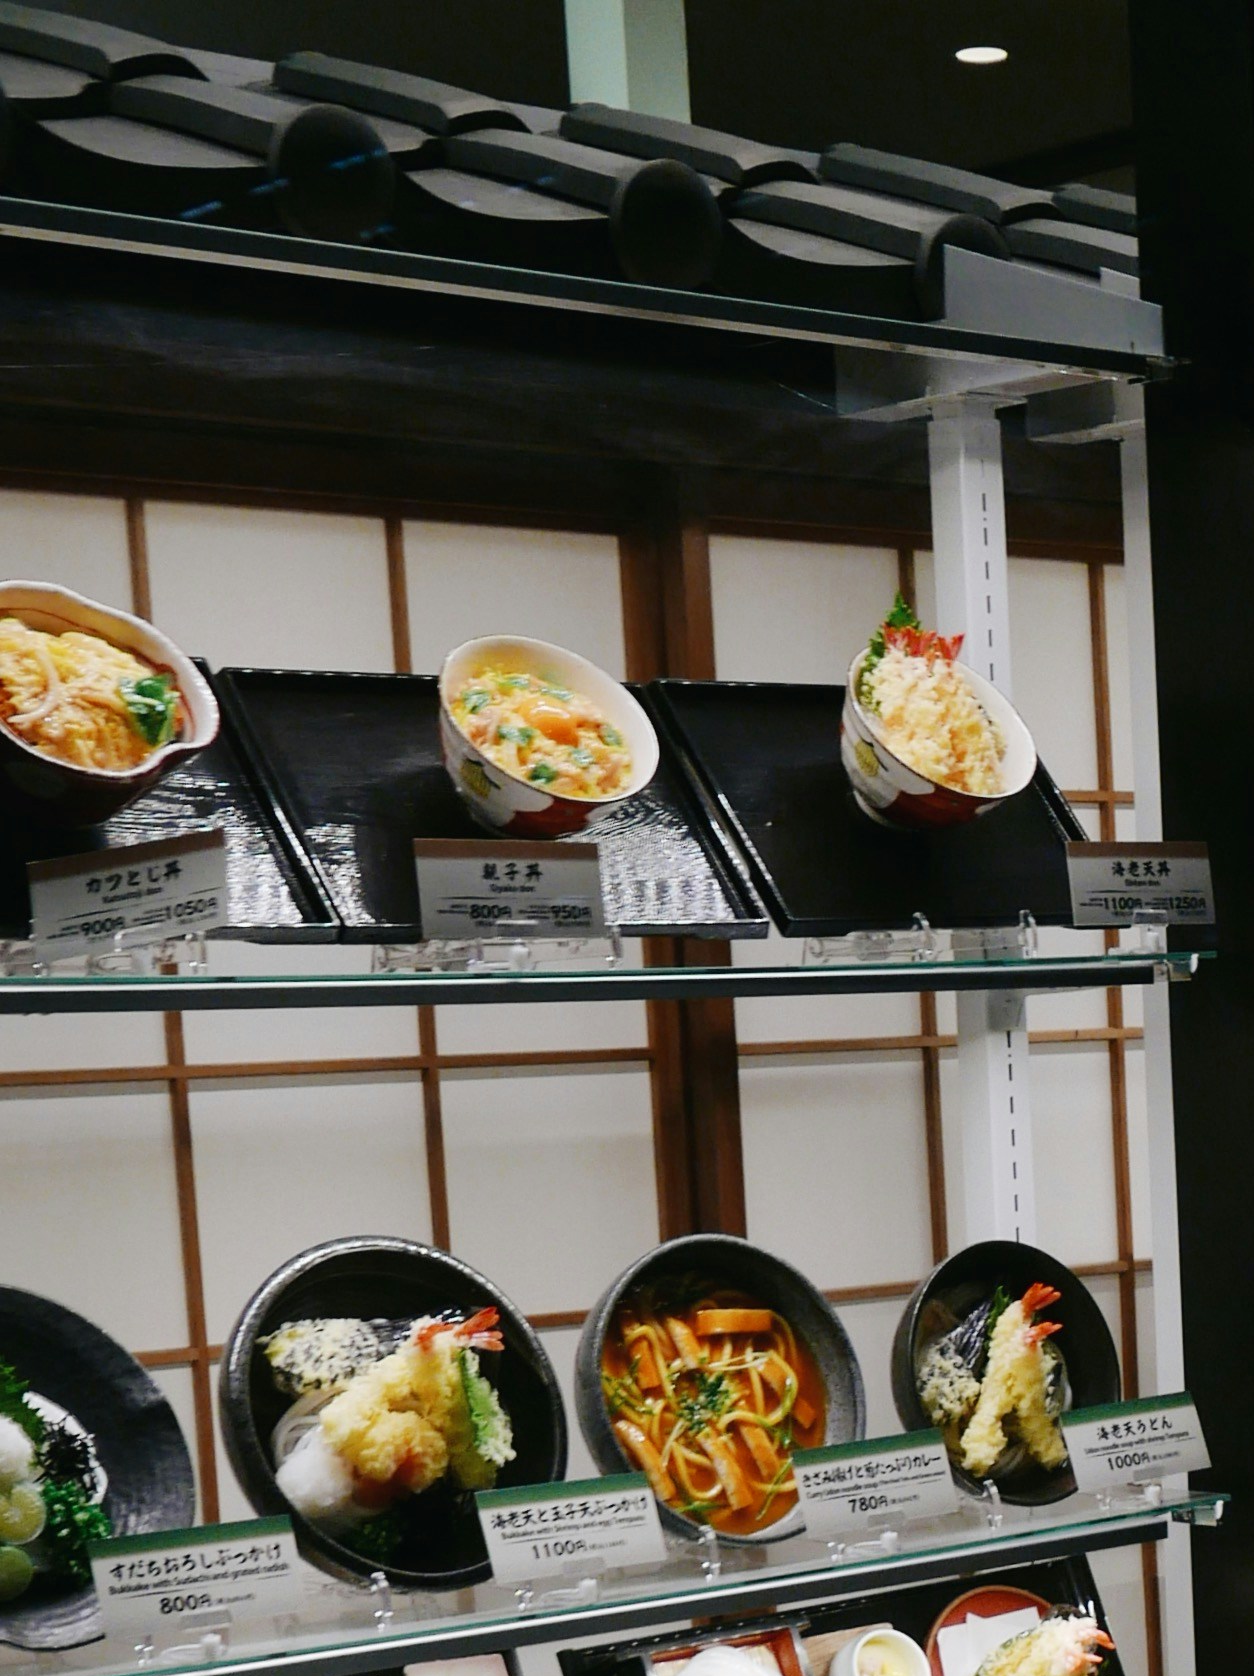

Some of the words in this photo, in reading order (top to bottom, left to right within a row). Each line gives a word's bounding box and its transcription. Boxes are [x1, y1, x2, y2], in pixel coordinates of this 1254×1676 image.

[85, 859, 181, 894] カツとじ丼
[481, 862, 542, 881] 親子丼
[1111, 860, 1170, 876] 海老天丼
[166, 896, 217, 919] 1050円
[469, 904, 511, 918] 800円
[550, 905, 591, 918] 950円
[1103, 897, 1142, 909] 1100円
[1168, 896, 1206, 909] 1250円
[80, 915, 125, 936] 900円
[1097, 1417, 1172, 1440] 海老天うどん
[1106, 1450, 1150, 1470] 1000円
[847, 1494, 888, 1513] 780円
[532, 1538, 587, 1558] 1100円
[159, 1592, 212, 1614] 800円
